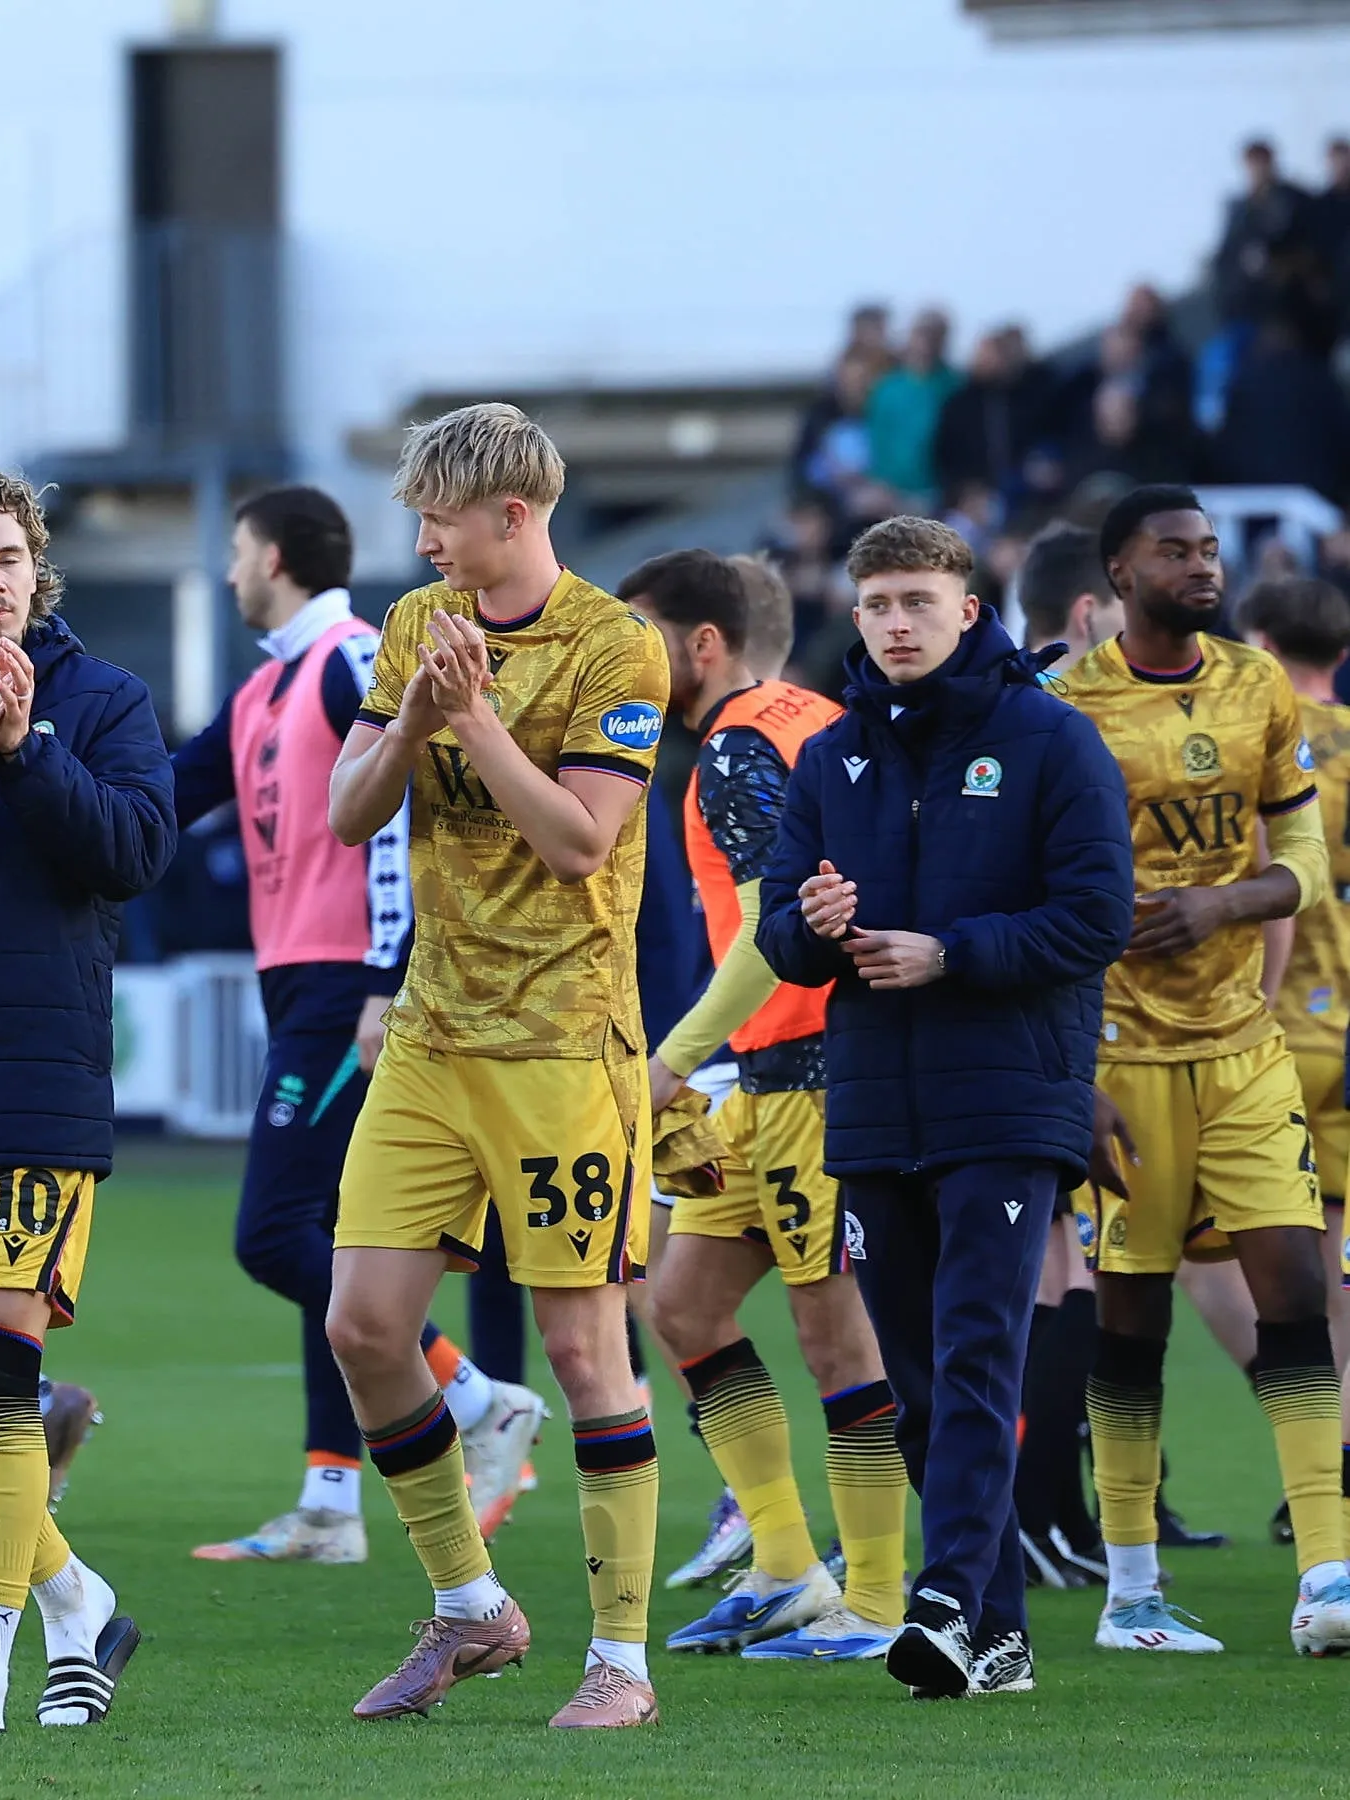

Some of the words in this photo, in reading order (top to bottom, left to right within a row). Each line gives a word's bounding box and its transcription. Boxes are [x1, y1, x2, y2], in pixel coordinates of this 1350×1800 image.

[607, 714, 660, 740] Venky's
[1147, 792, 1245, 854] WR
[520, 1152, 613, 1227] 38
[765, 1165, 810, 1232] 3
